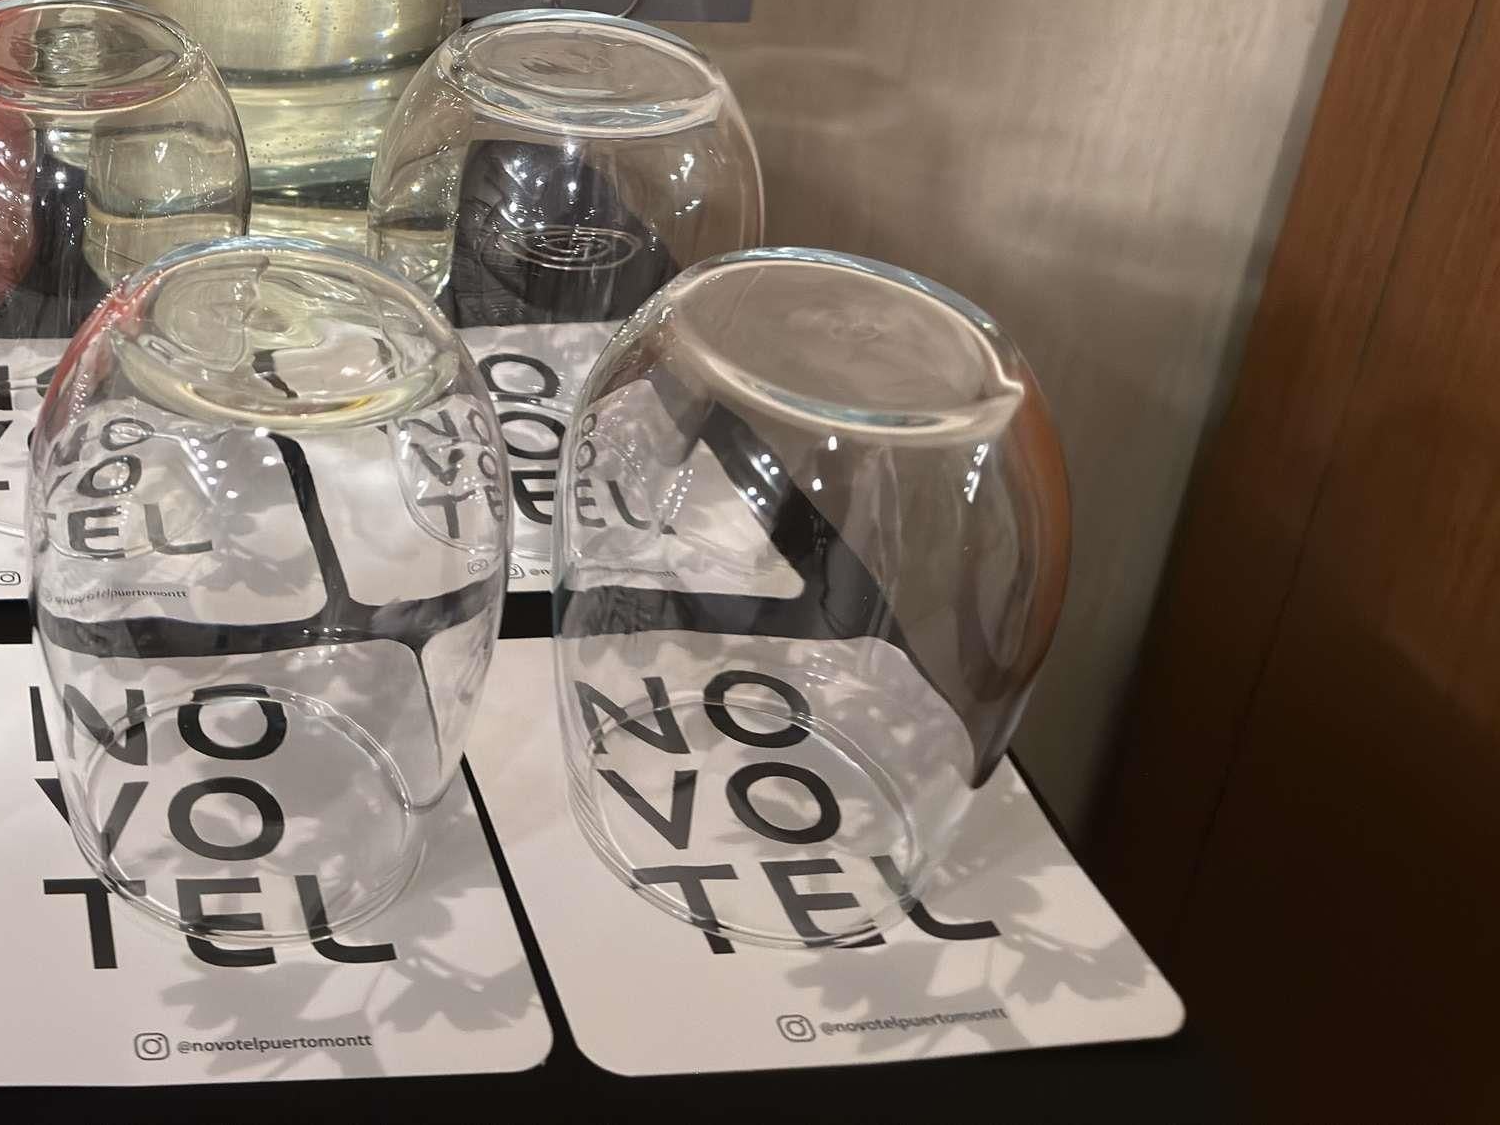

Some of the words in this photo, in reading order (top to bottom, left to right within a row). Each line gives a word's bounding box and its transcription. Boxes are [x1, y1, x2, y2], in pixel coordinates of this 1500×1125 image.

[29, 683, 288, 765] NO
[574, 669, 812, 755] NO
[34, 776, 285, 861] VO
[596, 761, 842, 850] VO
[43, 875, 398, 969] TEL
[631, 855, 1002, 954] TEL
[177, 1035, 373, 1053] @novotelpuertomontt
